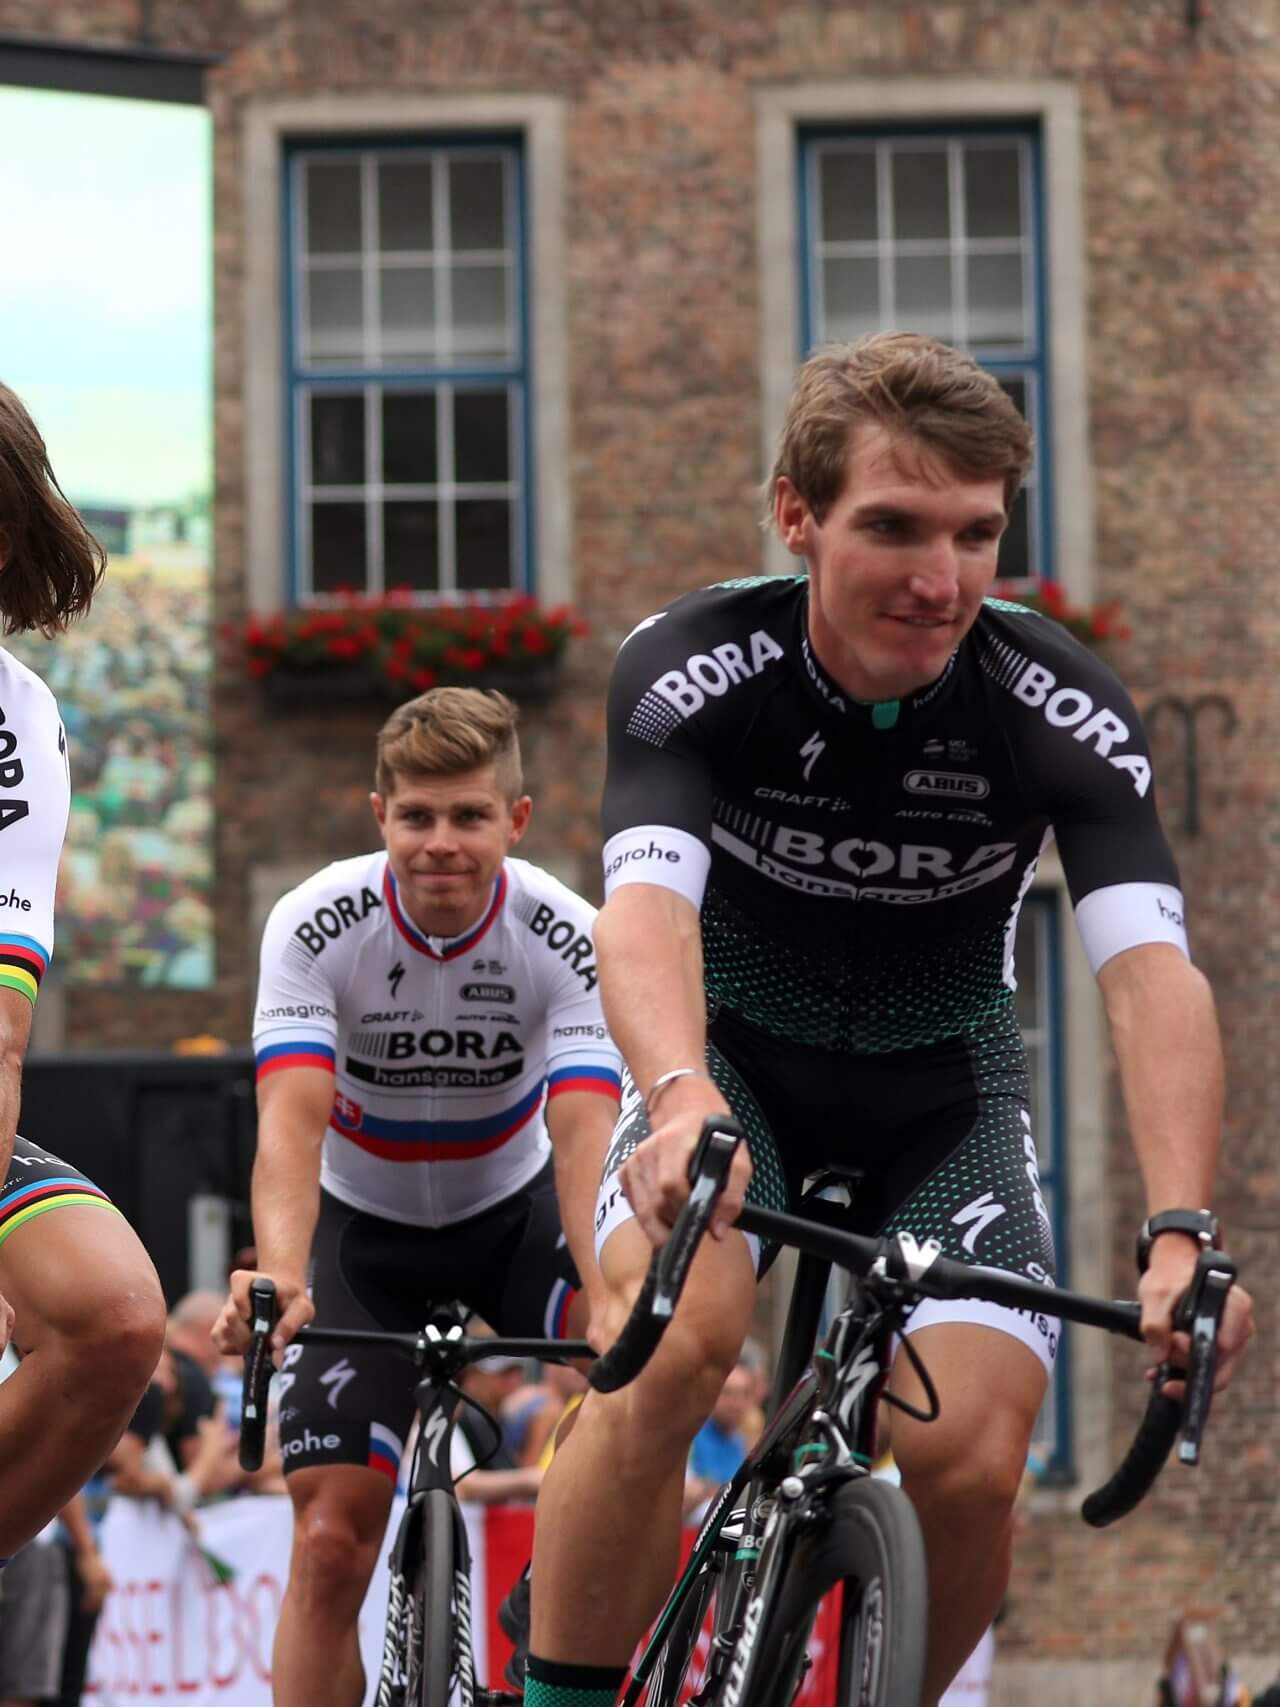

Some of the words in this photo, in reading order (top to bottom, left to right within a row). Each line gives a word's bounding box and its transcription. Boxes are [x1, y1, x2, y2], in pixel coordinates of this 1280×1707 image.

[651, 630, 784, 719] BORA
[1013, 662, 1151, 798] BORA
[754, 787, 830, 808] CRAFT
[916, 775, 979, 794] ABUS
[895, 810, 942, 819] AUTO
[773, 826, 1016, 879] BORA
[760, 853, 980, 904] hansgrohe
[294, 886, 382, 956] BORA
[469, 986, 510, 1000] ABUS
[361, 1011, 410, 1024] CRAFT
[387, 1029, 524, 1060] BORA
[374, 1066, 504, 1087] hansgrohe
